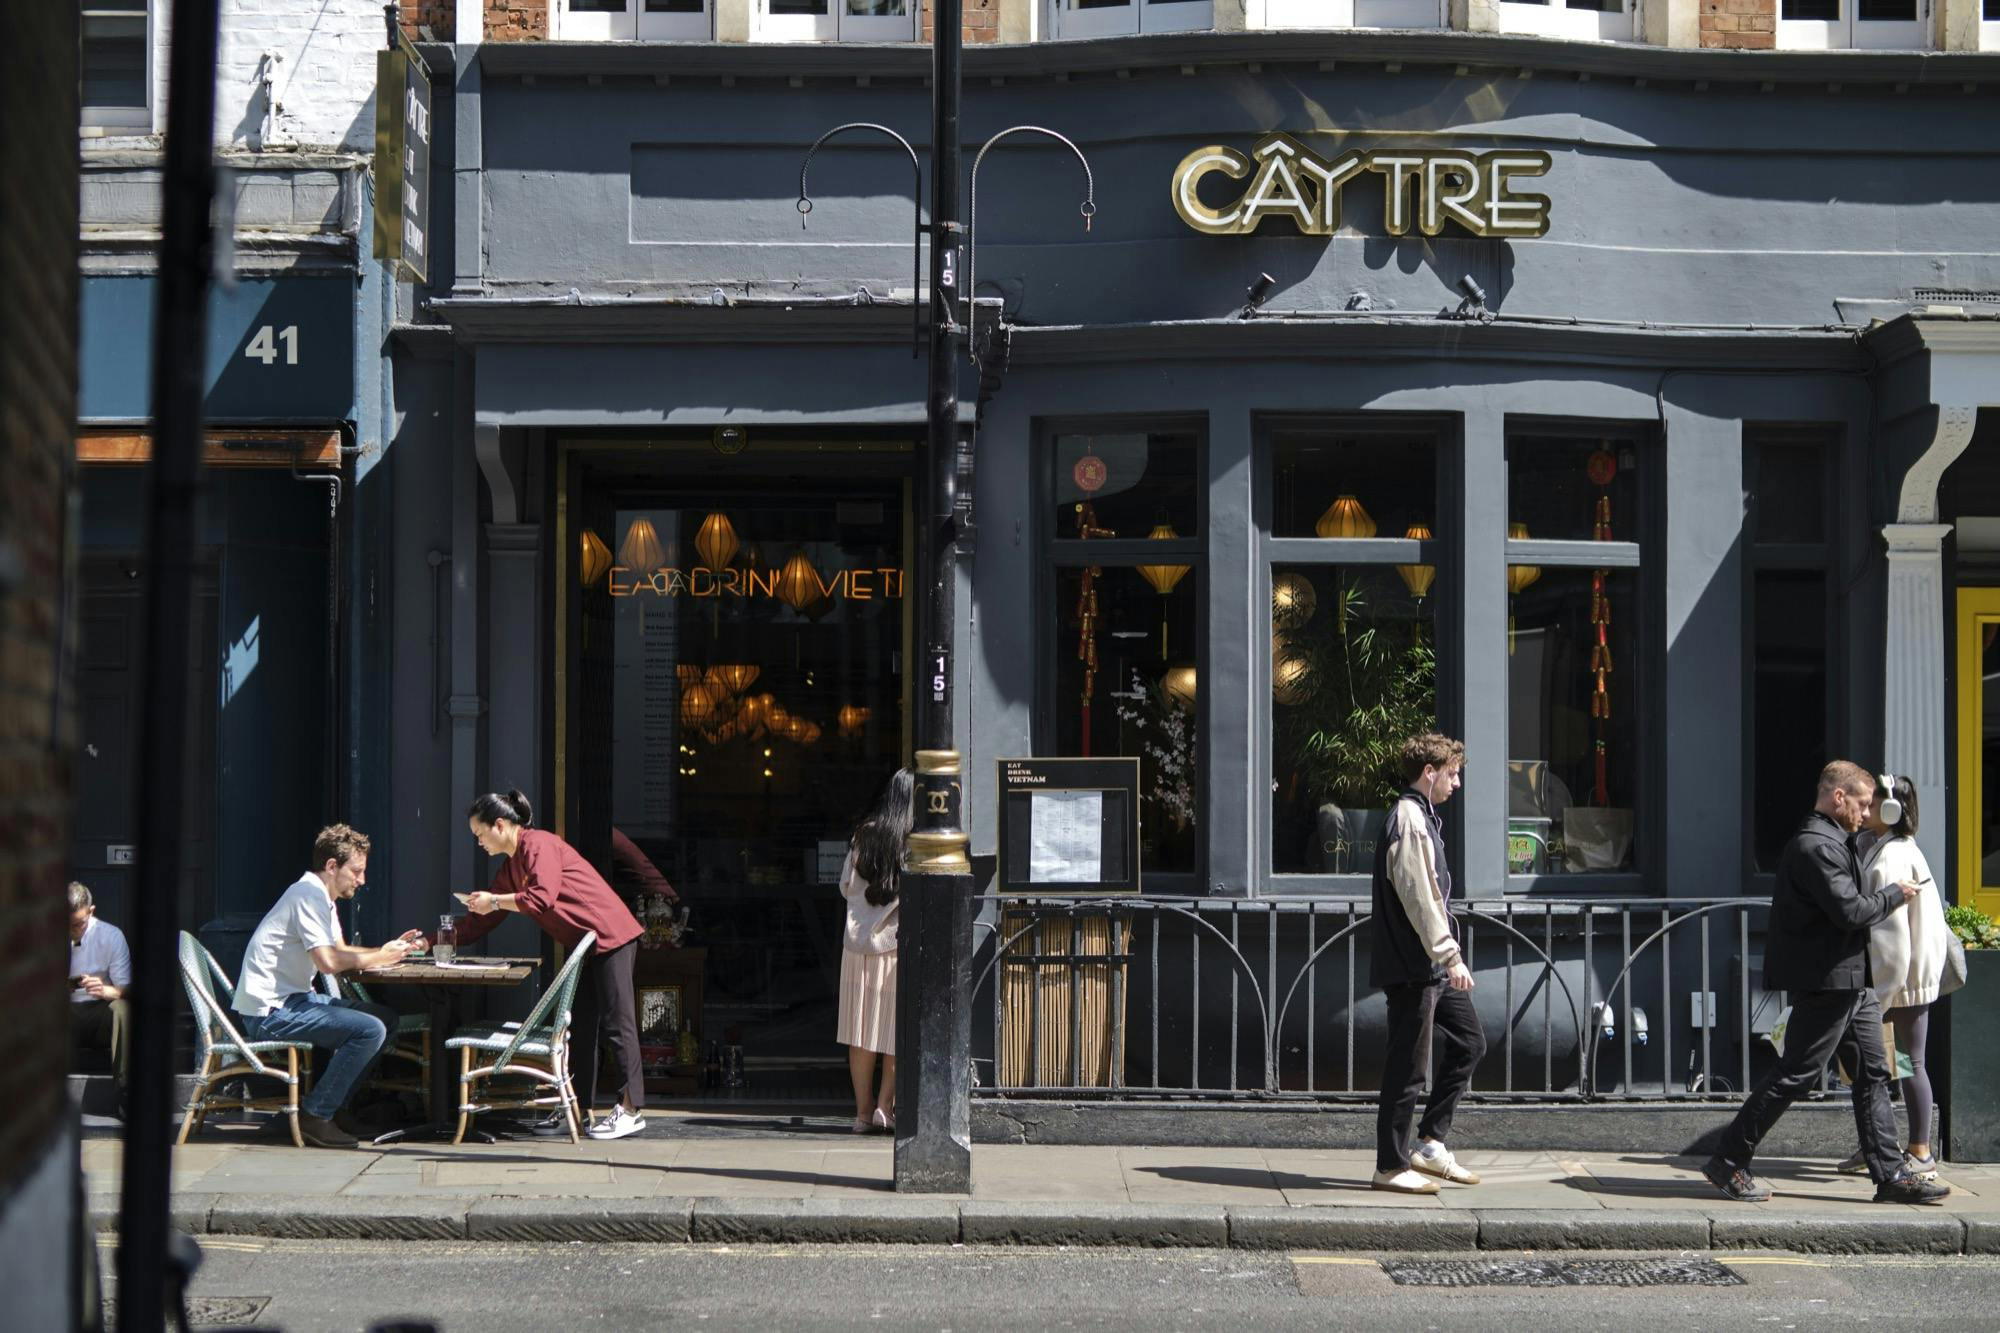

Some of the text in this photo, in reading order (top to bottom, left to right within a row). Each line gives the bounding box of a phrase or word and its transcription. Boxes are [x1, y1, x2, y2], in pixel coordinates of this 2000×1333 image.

[244, 325, 298, 365] 41
[608, 568, 676, 598] EAT
[691, 567, 781, 598] DRIN
[812, 568, 904, 600] VIET
